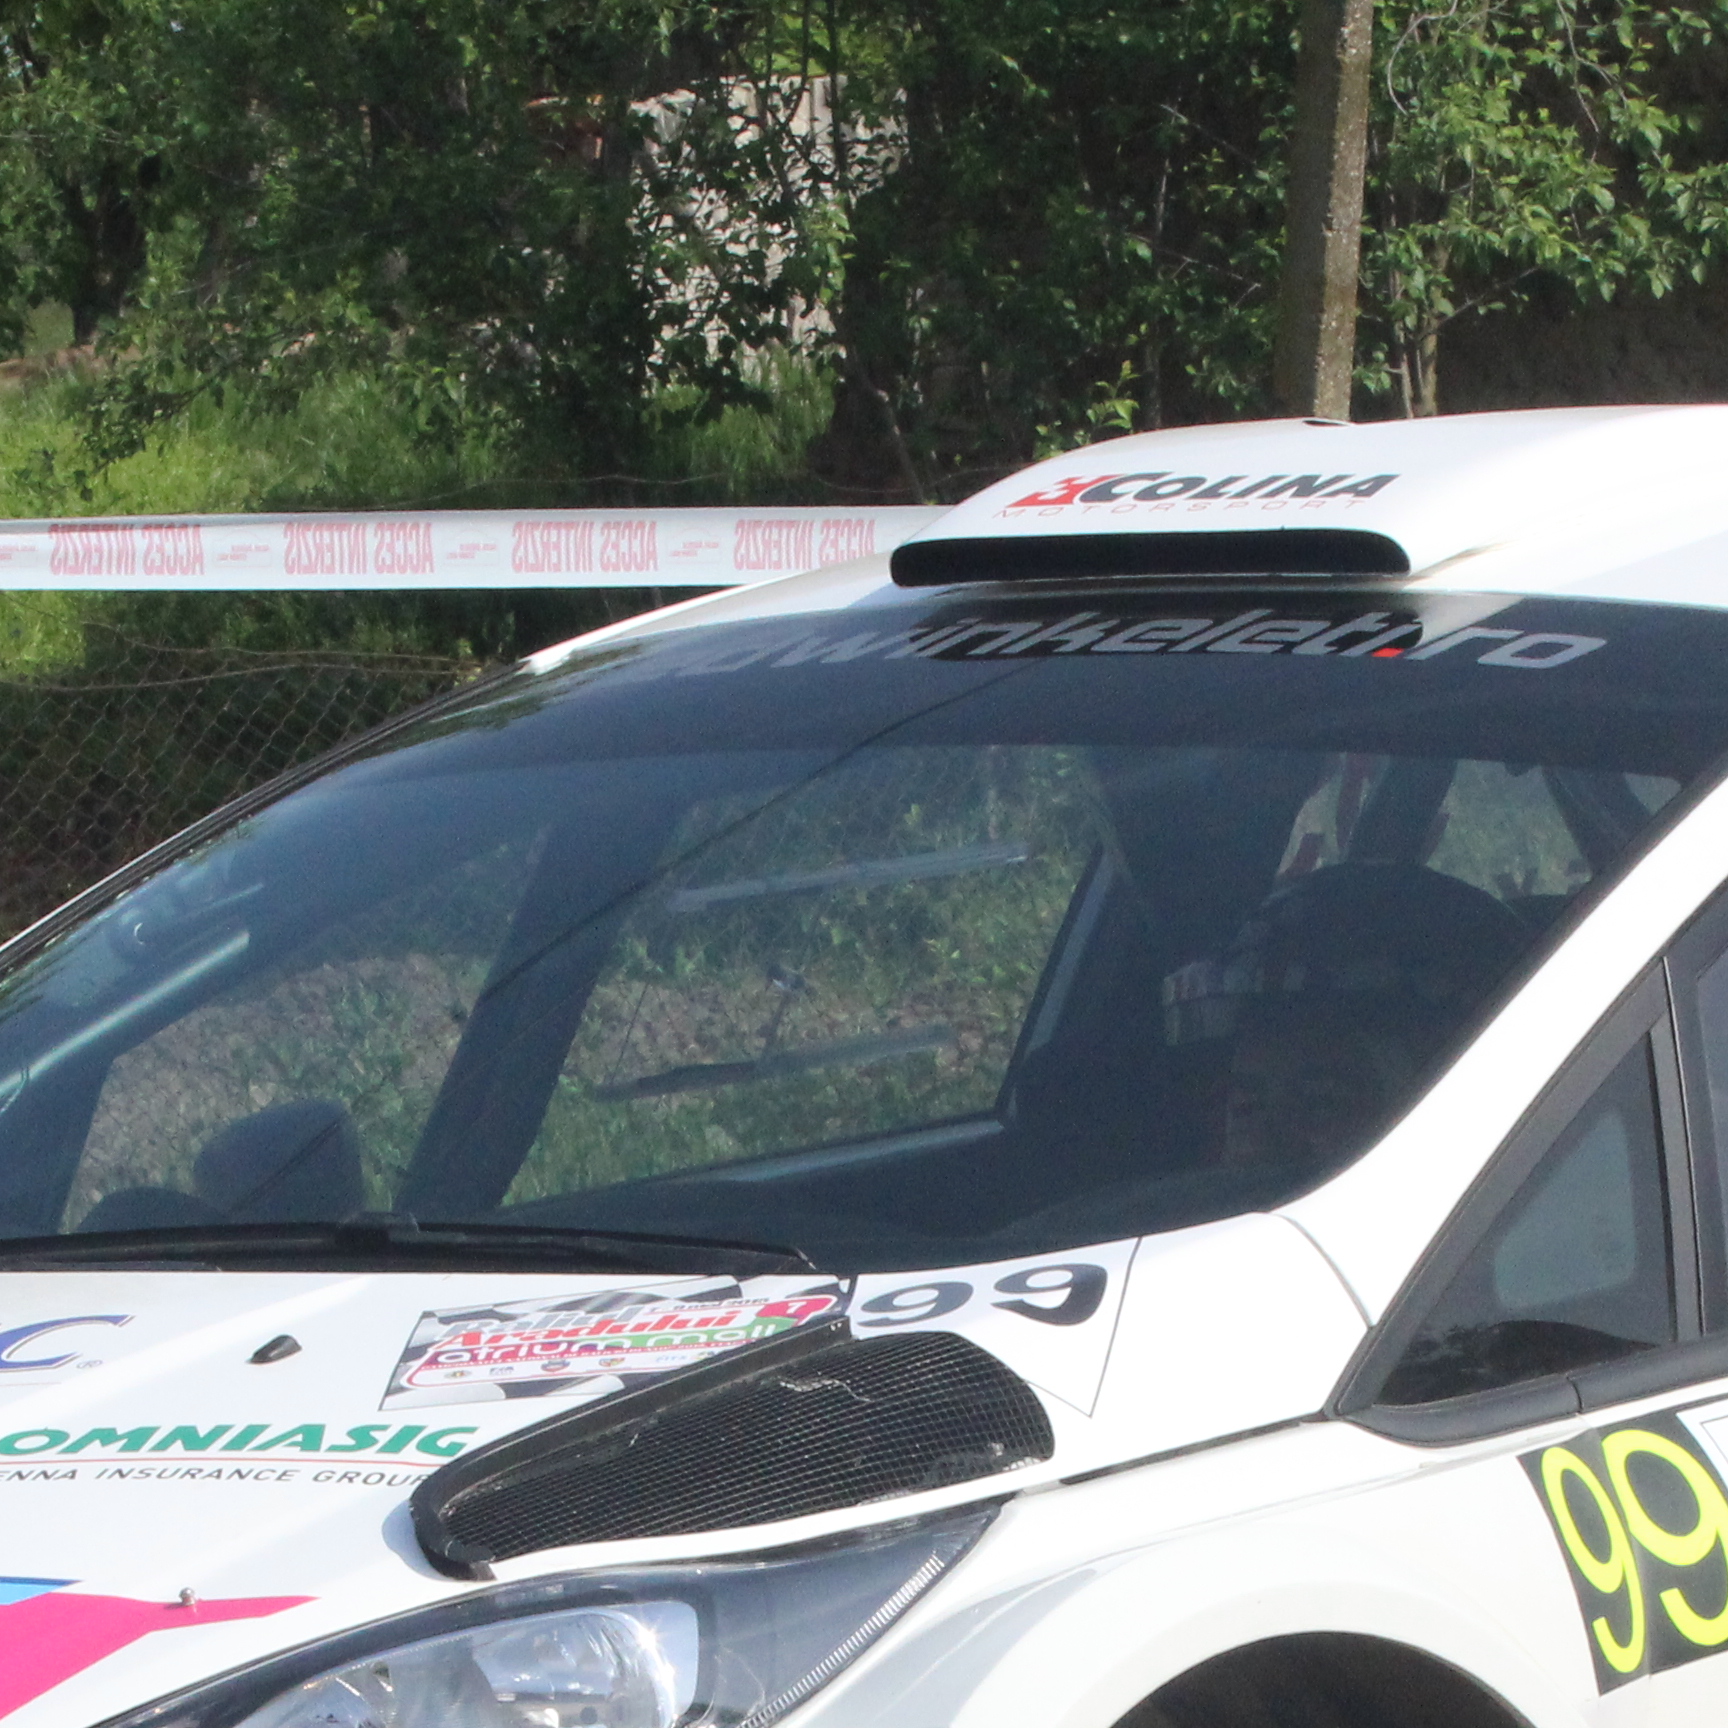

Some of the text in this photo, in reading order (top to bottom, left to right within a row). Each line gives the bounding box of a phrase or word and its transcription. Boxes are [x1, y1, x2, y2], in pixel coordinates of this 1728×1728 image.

[1080, 471, 1401, 503] COLINA
[991, 498, 1369, 519] MOTORSPORT
[856, 1263, 1108, 1328] 99
[433, 1309, 743, 1349] Aradului
[436, 1336, 632, 1365] atrium
[94, 1467, 308, 1485] INSURANCE
